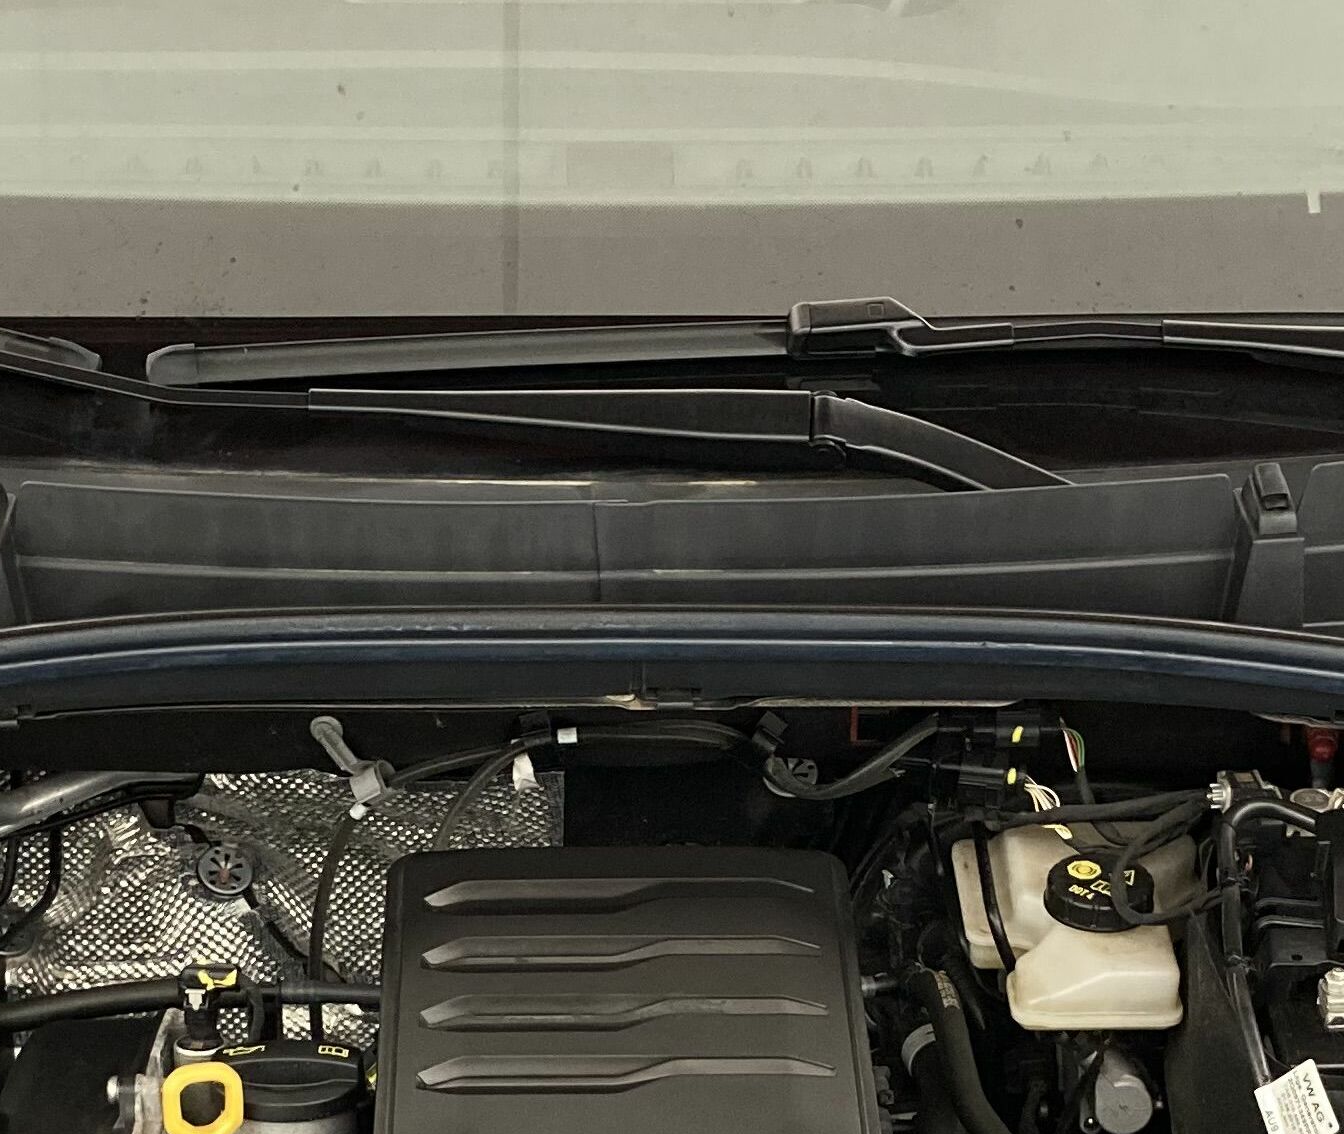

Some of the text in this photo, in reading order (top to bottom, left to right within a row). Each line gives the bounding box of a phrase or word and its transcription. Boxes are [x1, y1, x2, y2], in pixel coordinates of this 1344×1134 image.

[1303, 1073, 1325, 1123] VW AG
[1265, 1109, 1280, 1133] AU9
